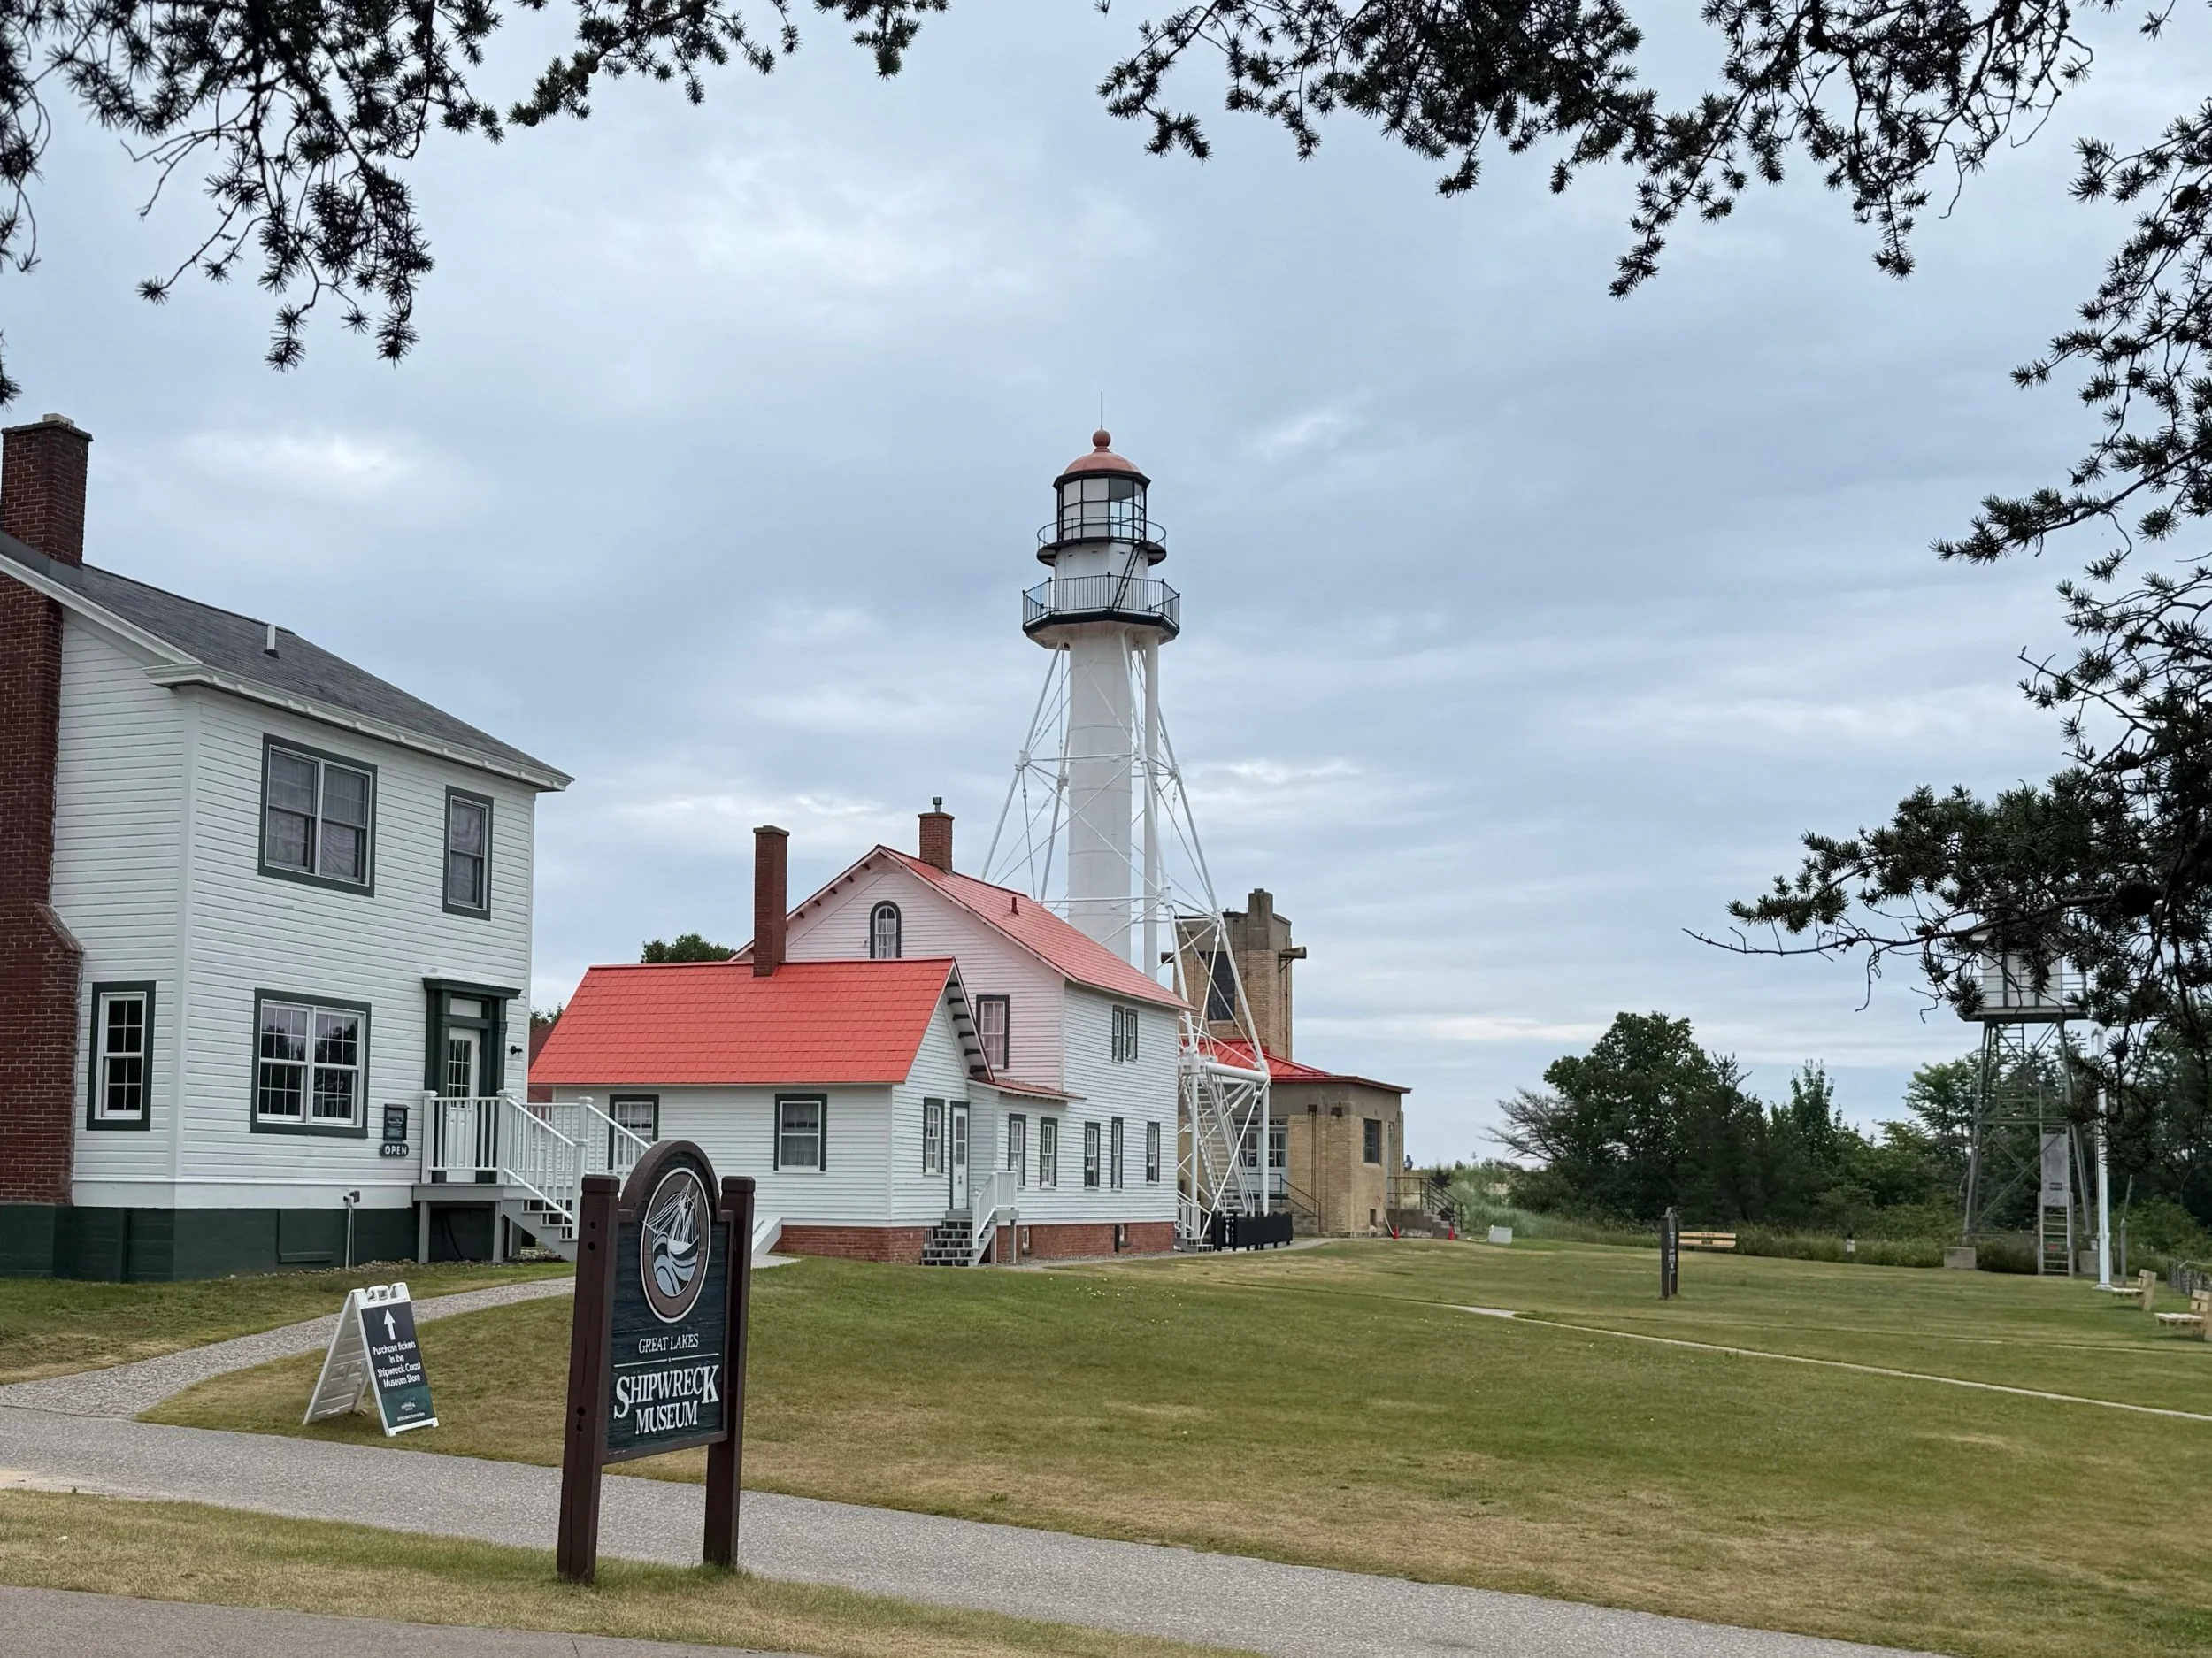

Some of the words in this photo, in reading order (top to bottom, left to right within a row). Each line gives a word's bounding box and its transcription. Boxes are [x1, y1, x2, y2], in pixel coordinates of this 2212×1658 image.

[384, 1145, 407, 1155] OPEN
[373, 1345, 397, 1355] Purchase
[397, 1340, 416, 1350] Tickets
[638, 1336, 669, 1354] GREAT
[669, 1333, 699, 1350] LAKES
[388, 1355, 396, 1363] in
[395, 1354, 404, 1362] the
[377, 1364, 405, 1378] Shipwreck
[404, 1361, 421, 1372] Coast
[383, 1377, 407, 1388] Museum
[406, 1374, 420, 1383] Store
[635, 1400, 698, 1435] MUSEUM
